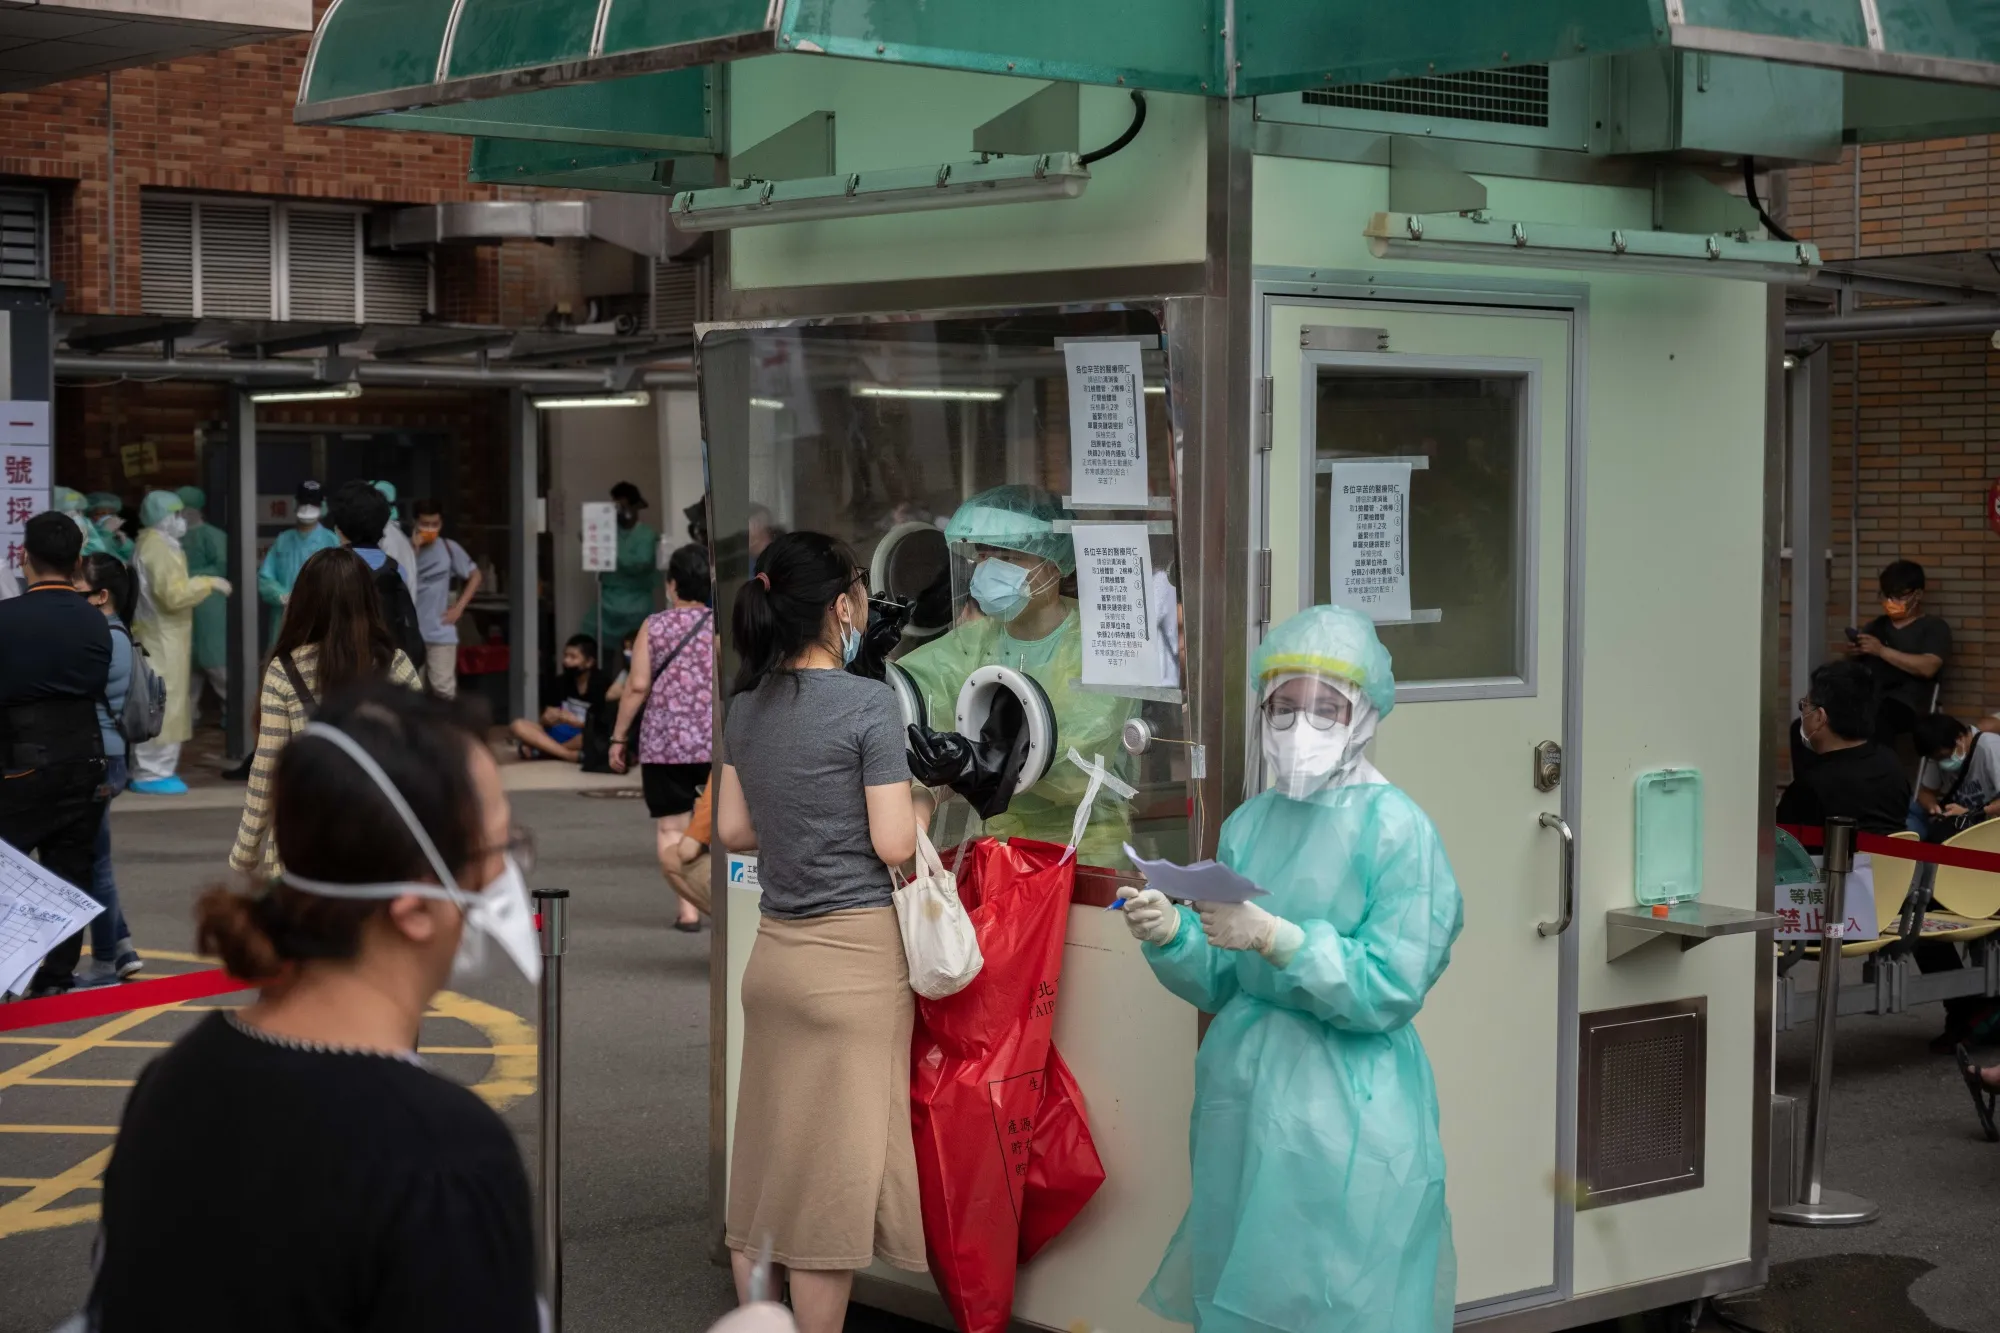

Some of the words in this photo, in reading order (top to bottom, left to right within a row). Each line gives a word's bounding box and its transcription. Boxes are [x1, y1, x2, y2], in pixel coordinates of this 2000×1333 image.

[1343, 484, 1400, 494] 各位辛苦的醫療同仁
[1084, 548, 1138, 556] 各位辛苦的醫療同仁
[1790, 889, 1826, 905] 等候
[1776, 908, 1861, 934] 禁止入
[1029, 1077, 1040, 1091] 生
